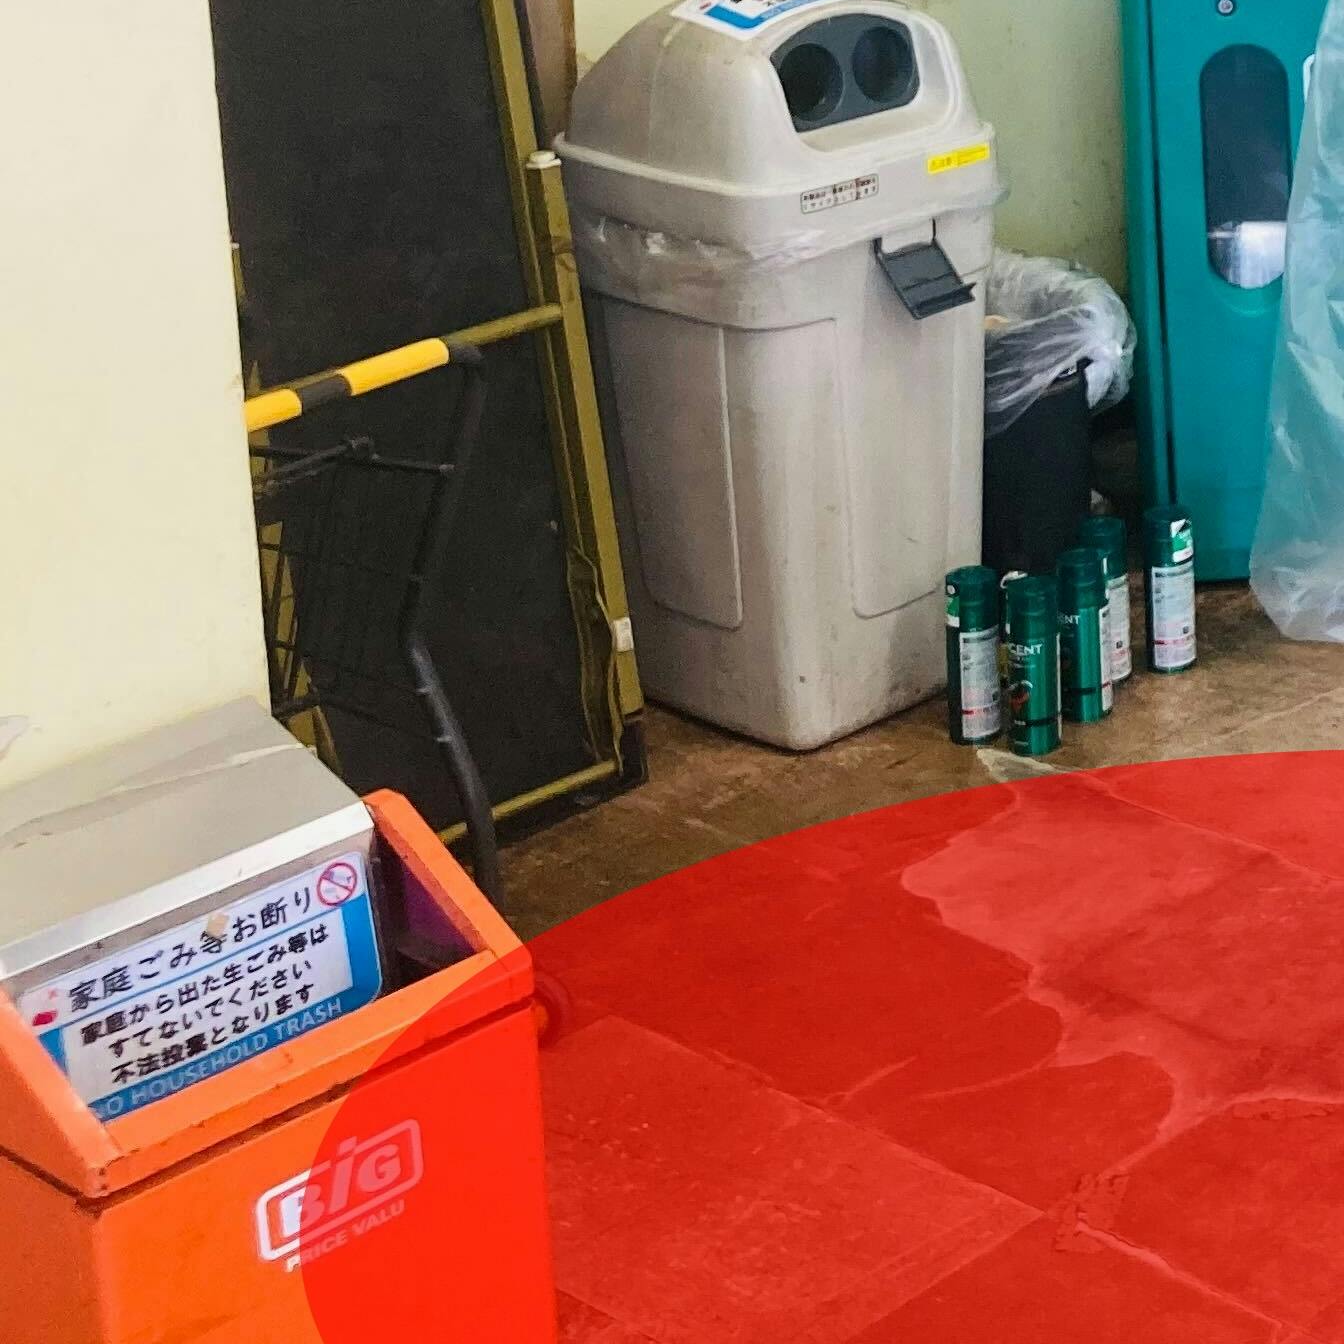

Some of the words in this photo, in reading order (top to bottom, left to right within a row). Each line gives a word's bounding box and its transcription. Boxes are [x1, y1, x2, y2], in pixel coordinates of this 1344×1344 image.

[67, 887, 311, 1012] 家庭ごみ等お断り
[80, 923, 329, 1045] 家庭から出た生ごみ等は
[107, 959, 313, 1057] すてないでください
[111, 984, 314, 1084] 不法投棄となります
[130, 1030, 269, 1103] HOUSEHOLD
[272, 998, 342, 1040] TRASH
